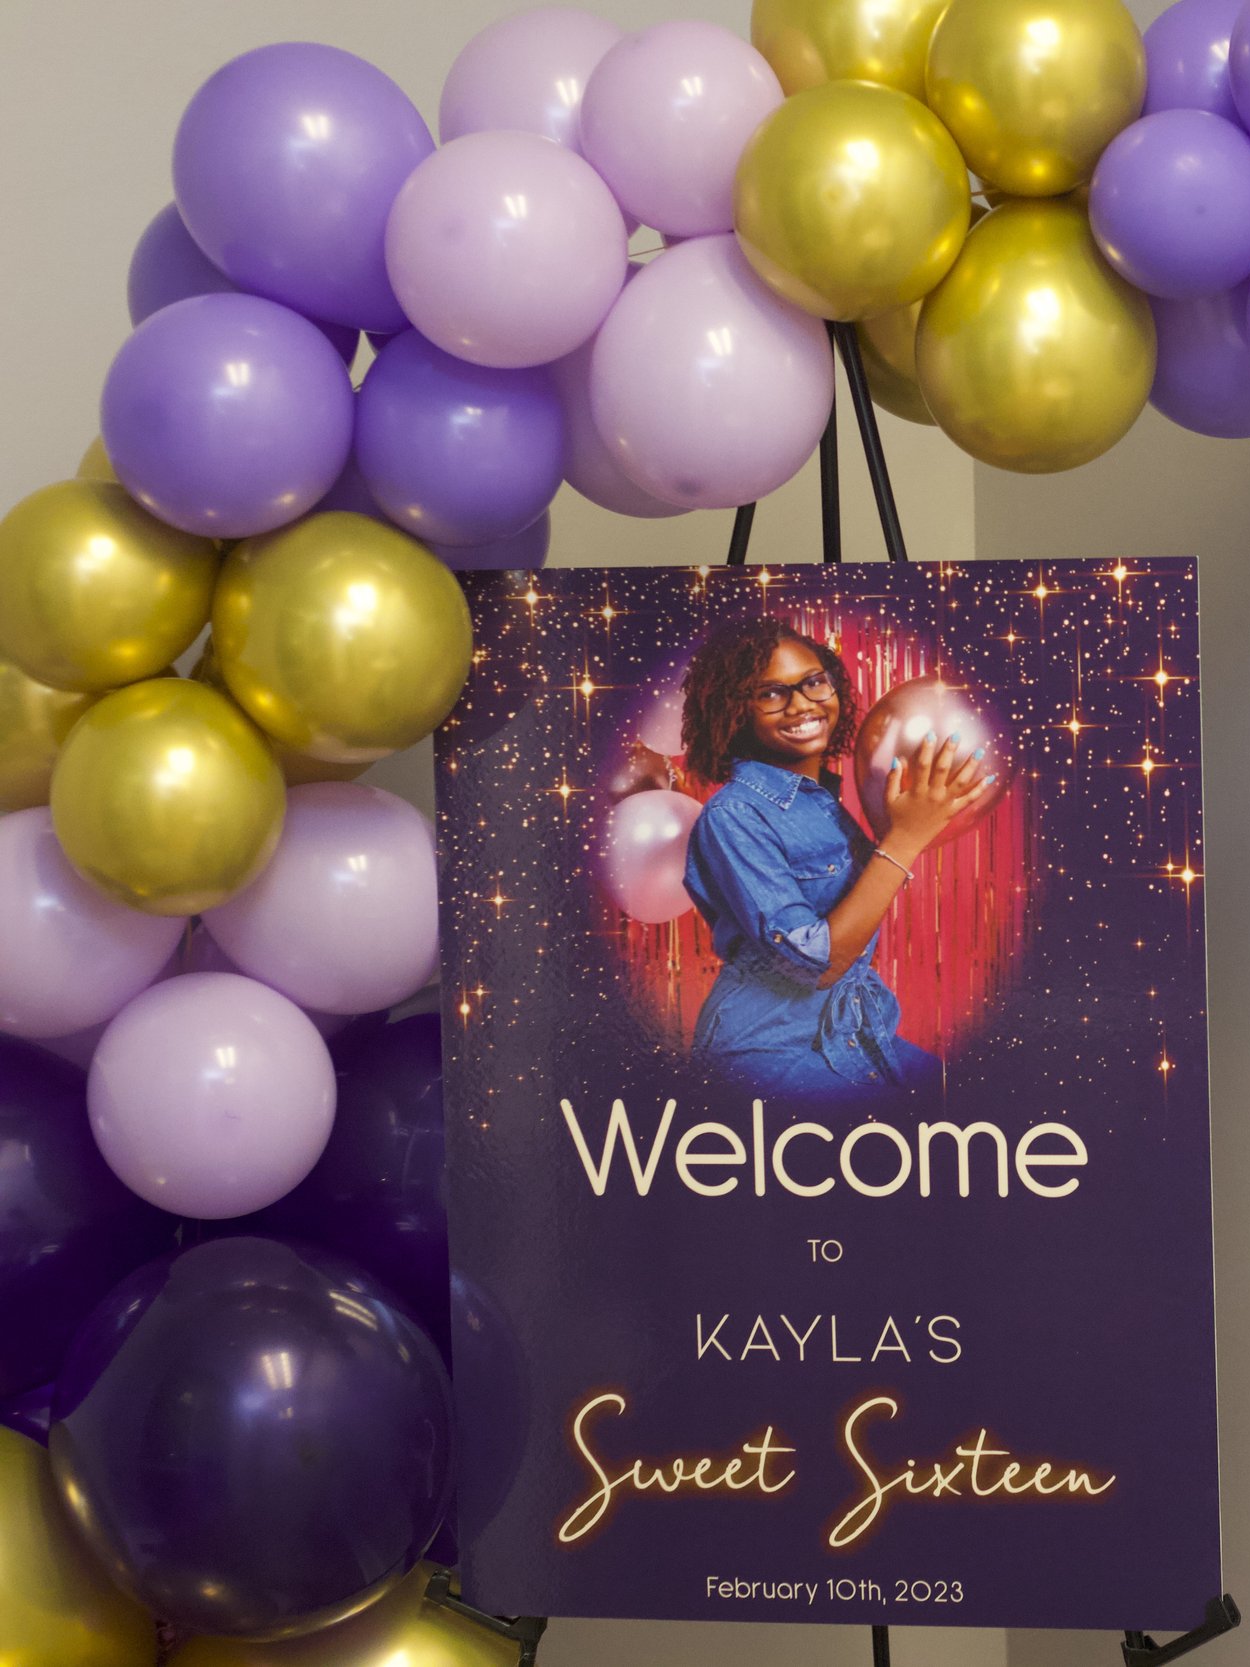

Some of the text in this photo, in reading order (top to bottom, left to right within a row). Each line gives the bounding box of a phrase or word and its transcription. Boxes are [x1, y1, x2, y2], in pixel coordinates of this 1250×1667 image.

[560, 1098, 1088, 1198] Welcome
[806, 1238, 844, 1263] TO
[696, 1313, 962, 1364] KAYLA'S
[558, 1393, 1116, 1548] Sweet Sixteen
[706, 1576, 964, 1606] February 10th, 2023
